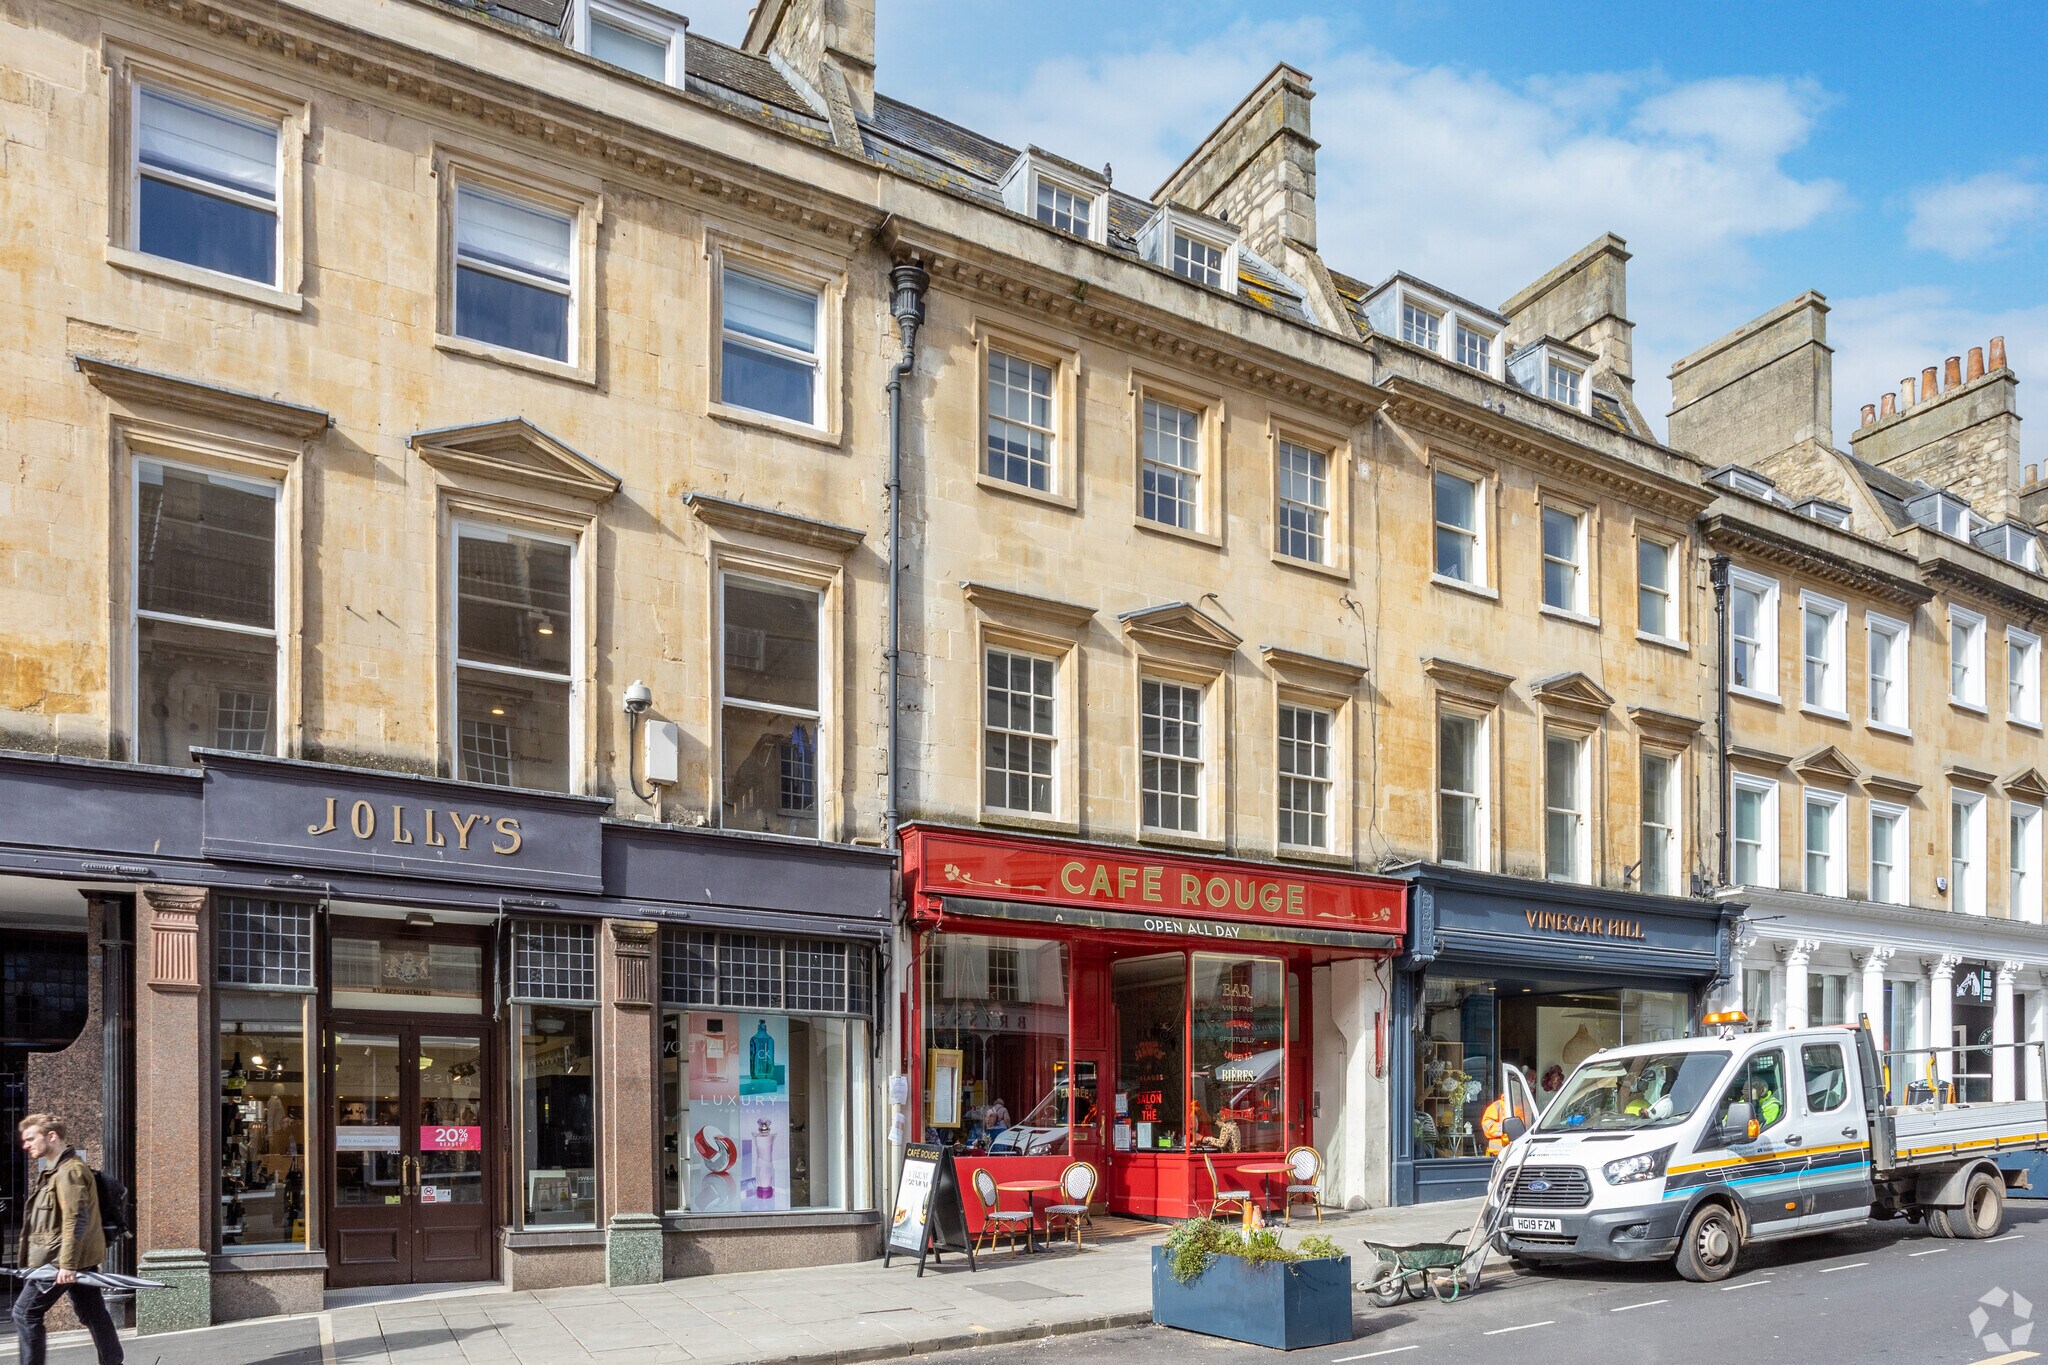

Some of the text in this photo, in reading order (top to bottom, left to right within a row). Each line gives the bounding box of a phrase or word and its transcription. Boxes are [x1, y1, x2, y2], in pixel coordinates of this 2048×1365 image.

[307, 797, 523, 855] JOLLY'S
[1061, 861, 1305, 915] CAFÉ ROUGE
[1144, 919, 1241, 938] OPEN ALL DAY
[1525, 909, 1645, 939] VINEGAR HILL
[384, 988, 432, 996] APPOINTMENT
[1222, 983, 1253, 998] BAR
[1221, 1067, 1254, 1082] BIÈRES
[1060, 1086, 1089, 1099] ENRÉE
[1136, 1093, 1162, 1104] SALON
[700, 1094, 778, 1106] LUXURY
[435, 1128, 469, 1142] 20%
[921, 1149, 940, 1160] ROUGE
[1518, 1219, 1556, 1231] HG19 FZM
